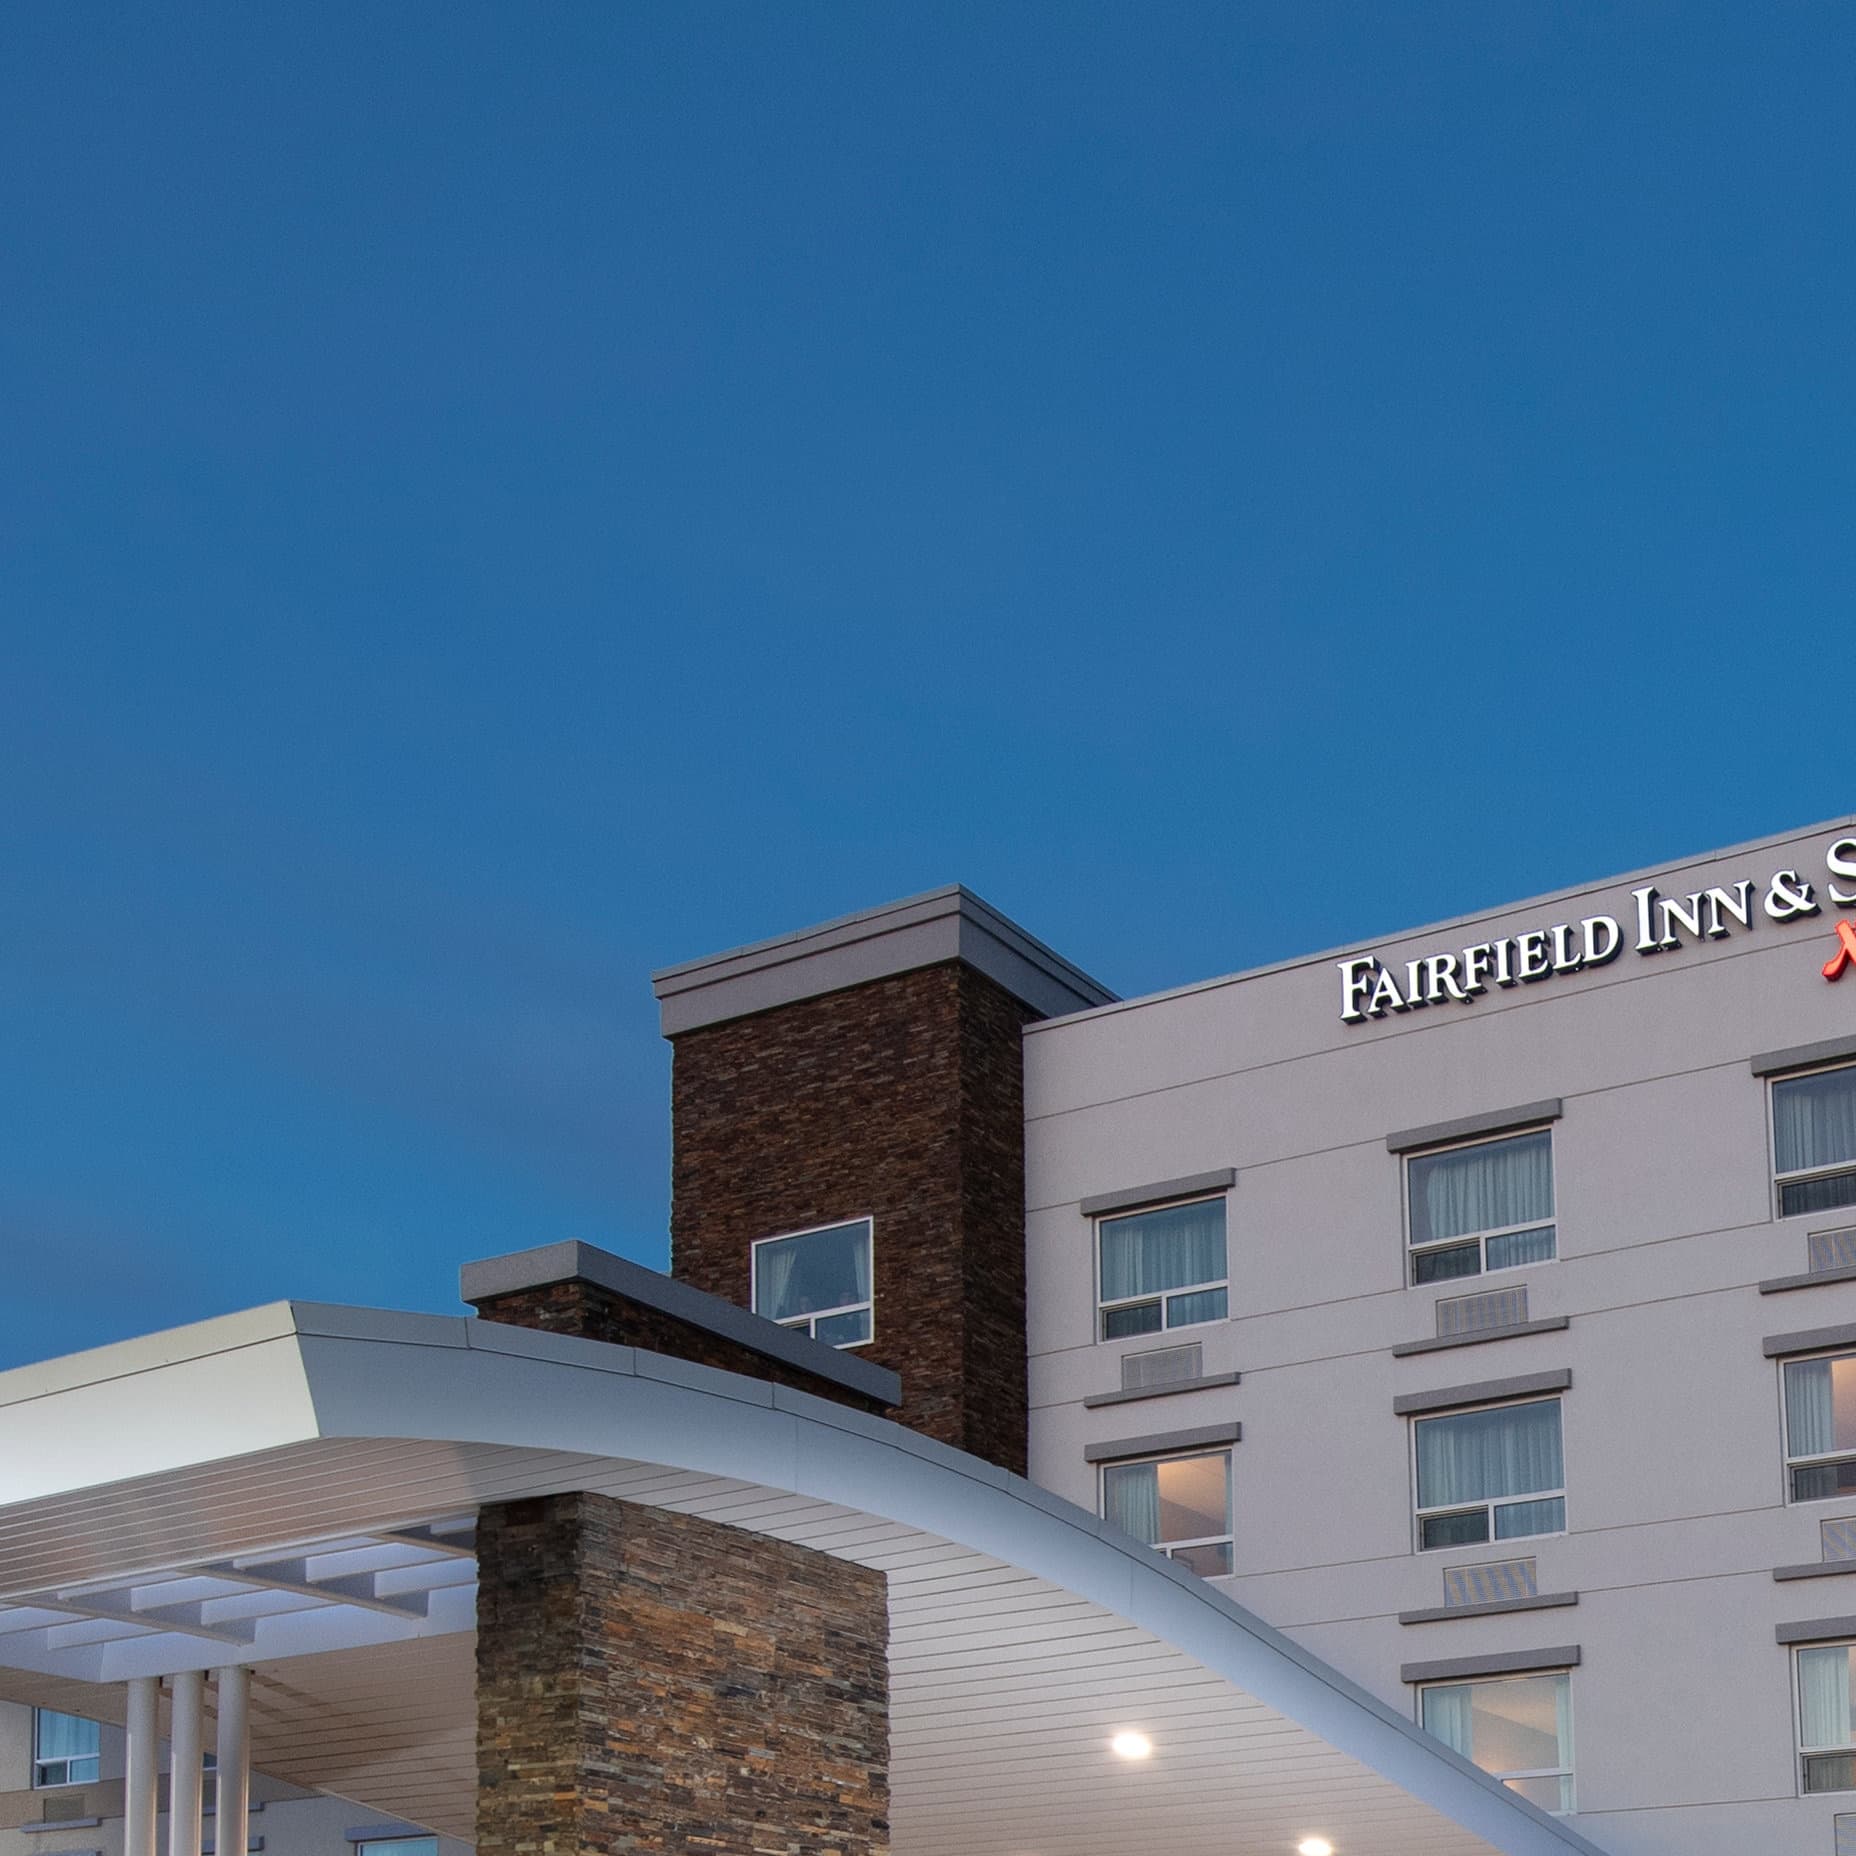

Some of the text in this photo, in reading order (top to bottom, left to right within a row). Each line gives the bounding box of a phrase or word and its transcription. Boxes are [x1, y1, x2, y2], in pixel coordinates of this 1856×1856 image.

[1337, 915, 1624, 1023] FAIRFIELD
[1631, 886, 1754, 953] INN
[1764, 869, 1821, 923] &
